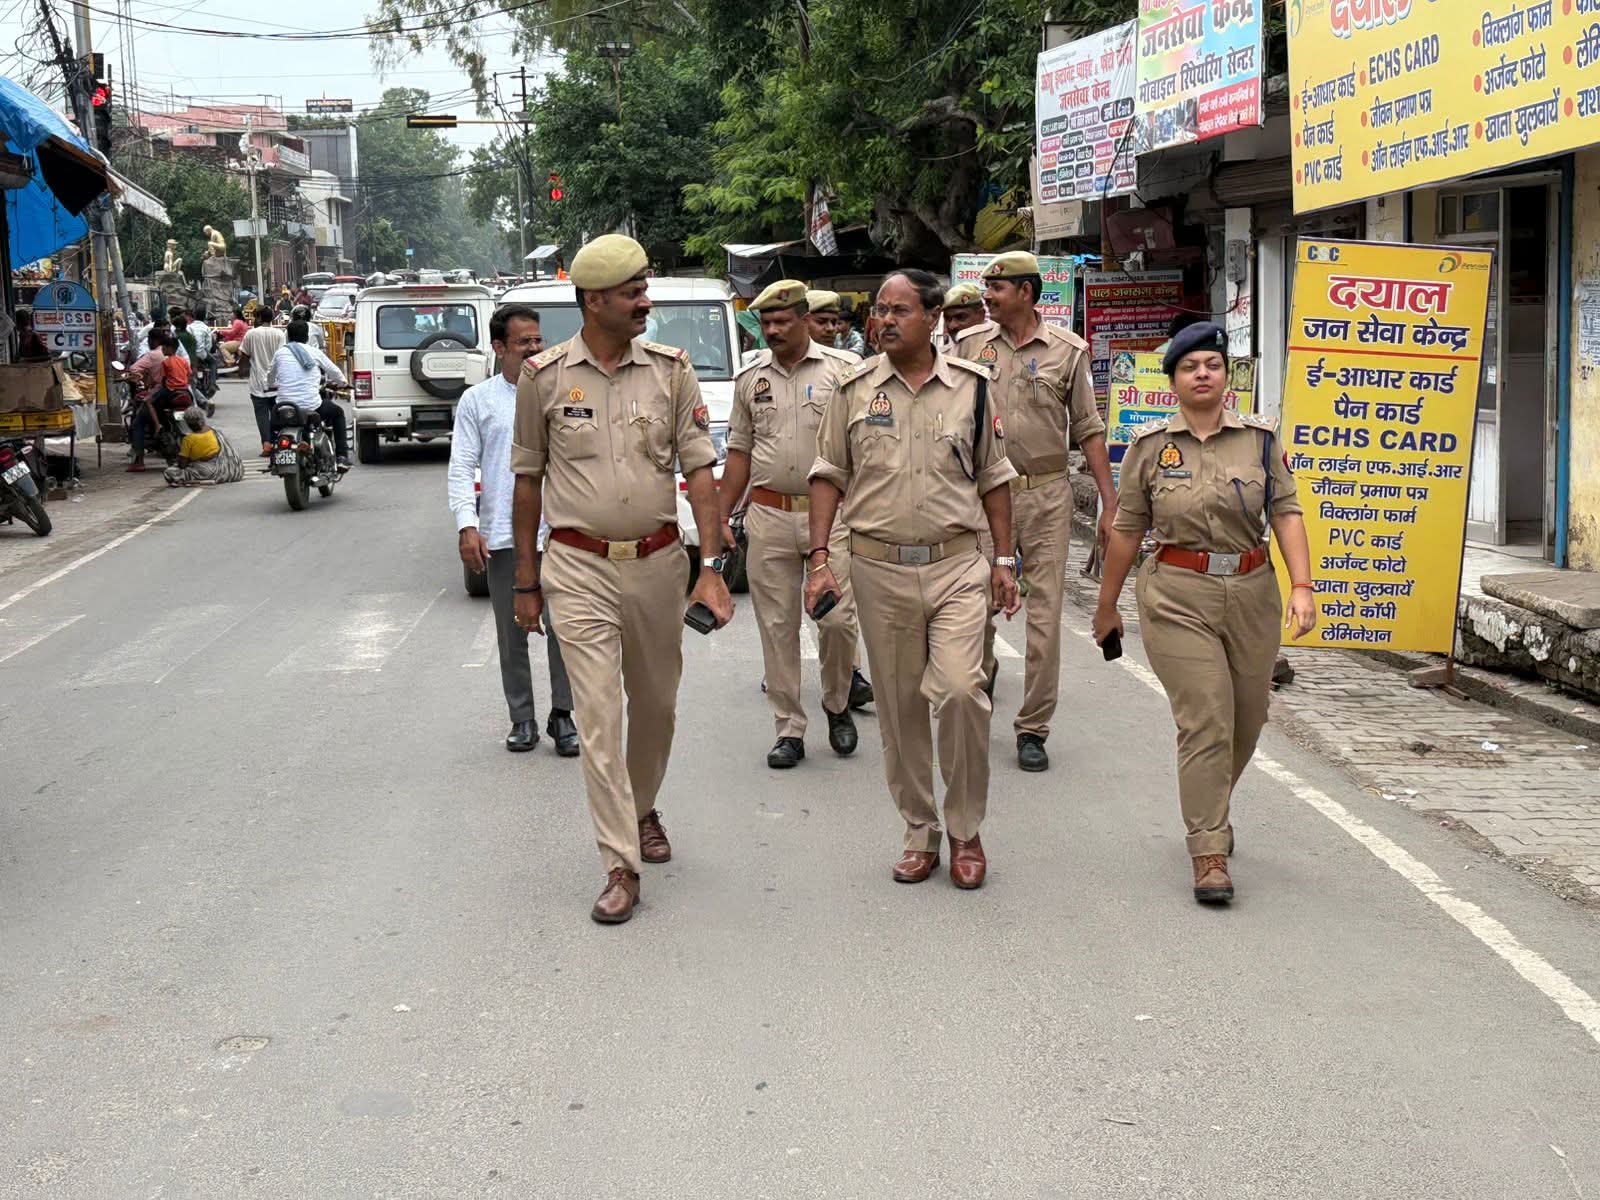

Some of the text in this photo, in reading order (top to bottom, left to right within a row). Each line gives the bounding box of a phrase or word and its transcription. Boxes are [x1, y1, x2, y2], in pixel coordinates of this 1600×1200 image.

[1141, 4, 1205, 57] जनसेवा
[1482, 4, 1524, 48] विक्लांग
[1369, 34, 1440, 85] ECHS CARD
[1484, 43, 1546, 95] अर्जेन्ट फोटो
[1139, 77, 1177, 104] मोबाइल
[1302, 61, 1356, 115] ई-आधार कार्ड
[1370, 89, 1432, 128] जीवन प्रमाण पत्र
[1484, 87, 1561, 146] खाता खुलवायें
[1303, 109, 1335, 149] पैन कार्ड
[1304, 144, 1343, 186] PVC कार्ड
[1371, 140, 1388, 172] ऑन
[1389, 131, 1412, 169] लाईन
[1307, 245, 1341, 263] CSC
[1328, 275, 1453, 314] दयाल
[64, 312, 92, 323] CSC
[1303, 313, 1471, 352] जन सेवा केन्द्र
[1306, 358, 1458, 393] ई-आधार कार्ड
[1117, 386, 1140, 408] श्री
[1334, 392, 1424, 424] पैन कार्ड
[1293, 425, 1457, 453] ECHS CARD
[1318, 454, 1361, 474] लाईन
[1366, 458, 1463, 479] एफ.आई.आर
[1311, 477, 1429, 501] जीवन प्रमाण पत्र
[1320, 501, 1418, 523] विक्लांग फार्म
[1329, 528, 1404, 550] PVC कार्ड
[1320, 552, 1408, 573] अर्जेन्ट फोटो
[1353, 580, 1415, 600] खुलवायें
[1321, 600, 1397, 620] फोटो कॉपी
[1321, 623, 1393, 643] लेमिनेशन
